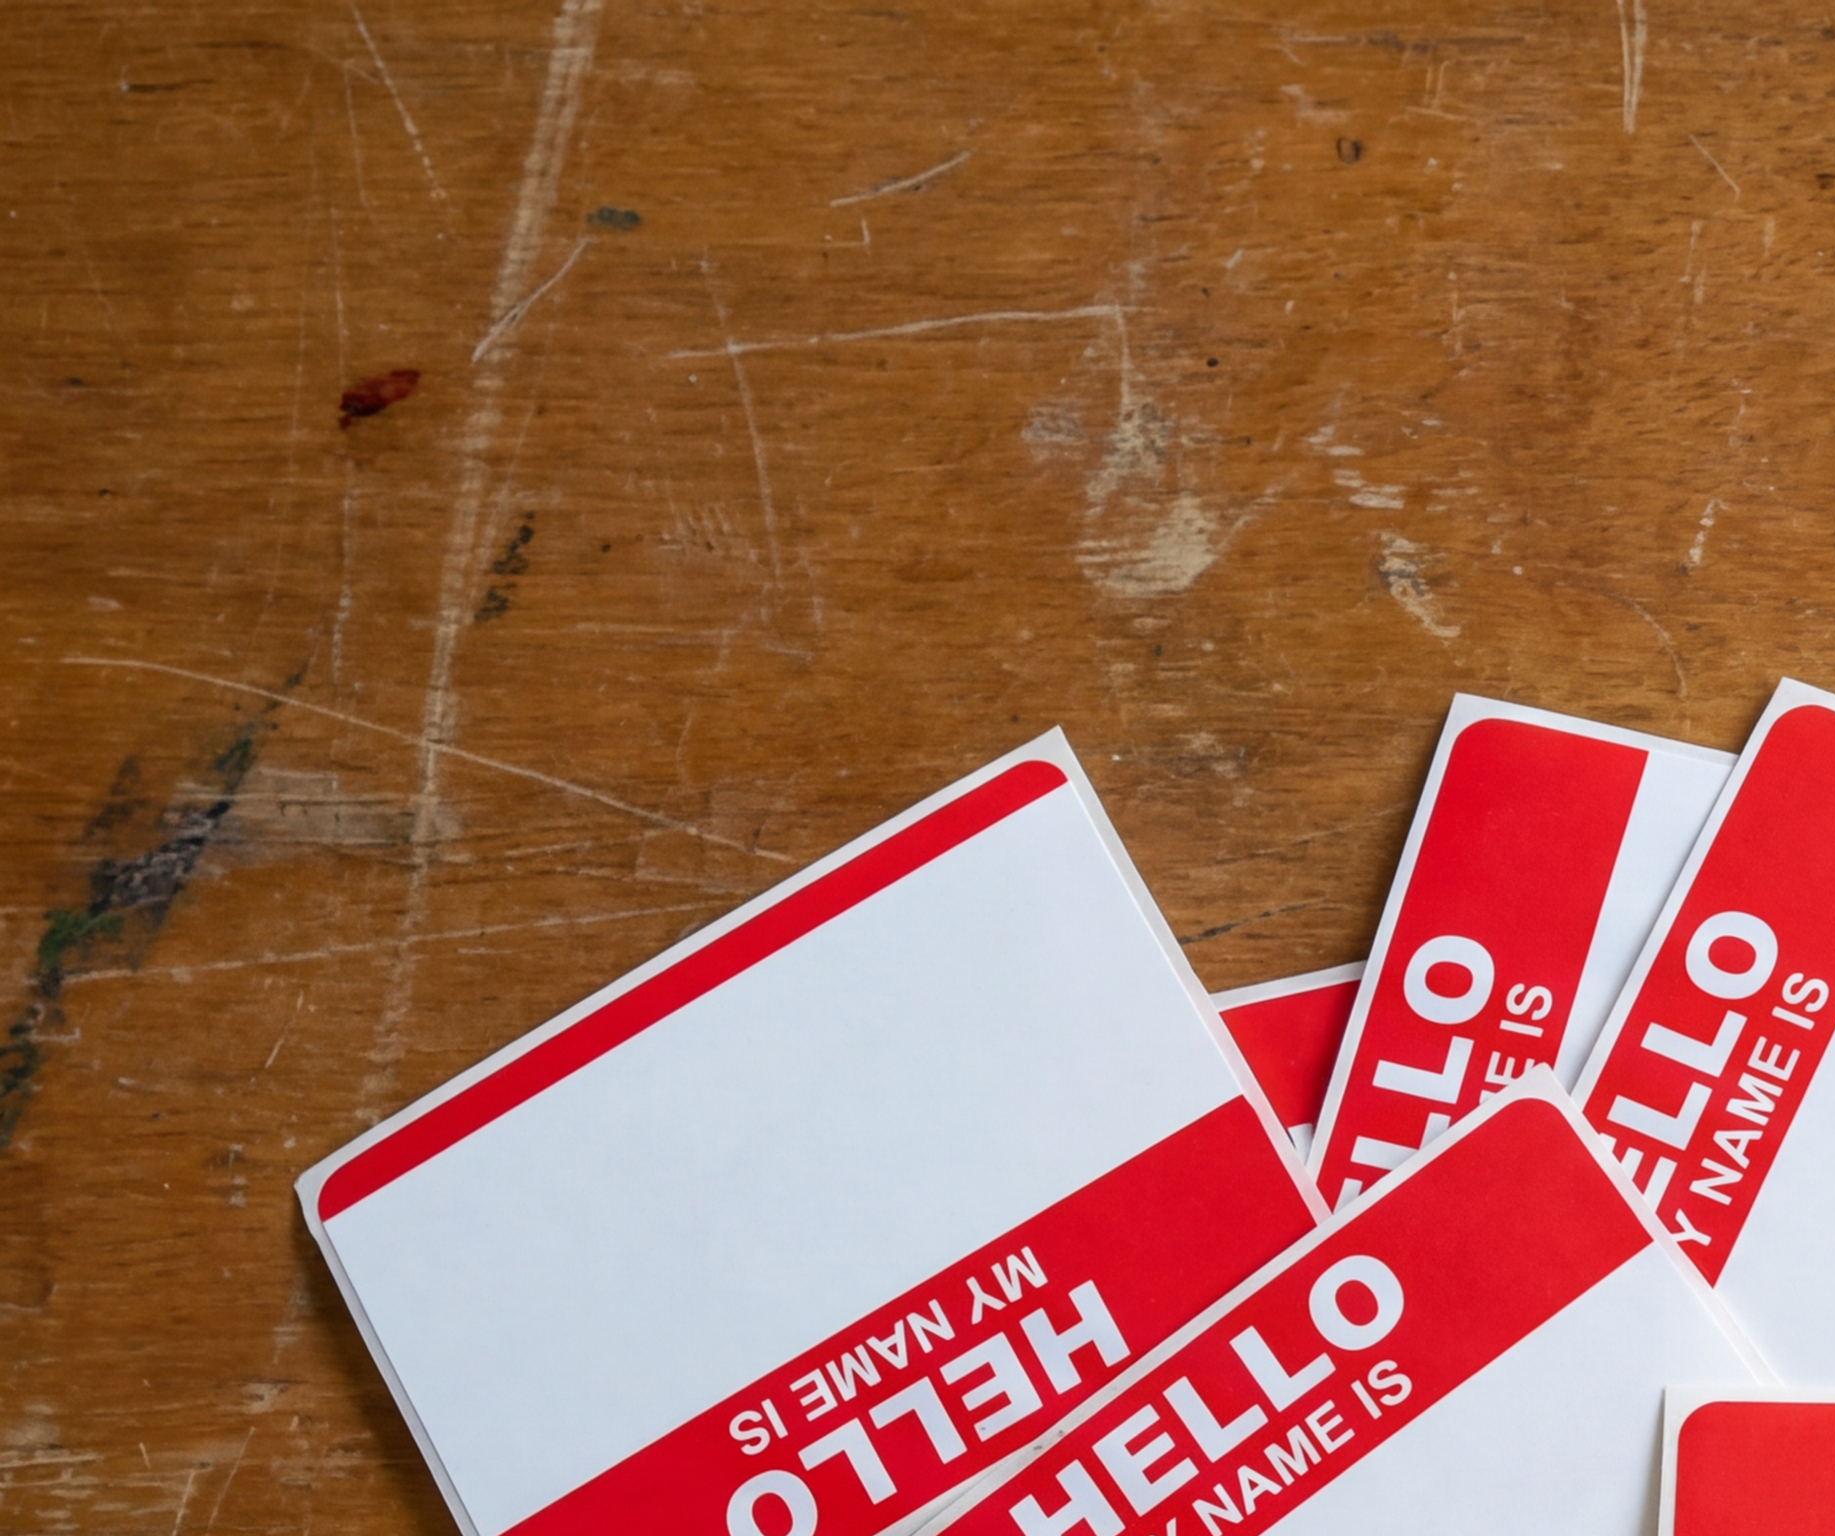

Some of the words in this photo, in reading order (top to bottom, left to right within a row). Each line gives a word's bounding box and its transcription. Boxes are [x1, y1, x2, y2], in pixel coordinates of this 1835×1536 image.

[1500, 984, 1552, 1037] IS
[1772, 973, 1829, 1030] IS
[1333, 935, 1494, 1213] LLO
[1690, 1036, 1800, 1205] NAME
[1671, 1209, 1712, 1247] Y
[967, 1246, 1047, 1324] MY
[790, 1299, 955, 1421] NAME
[1351, 1360, 1412, 1419] IS
[730, 1399, 788, 1454] IS
